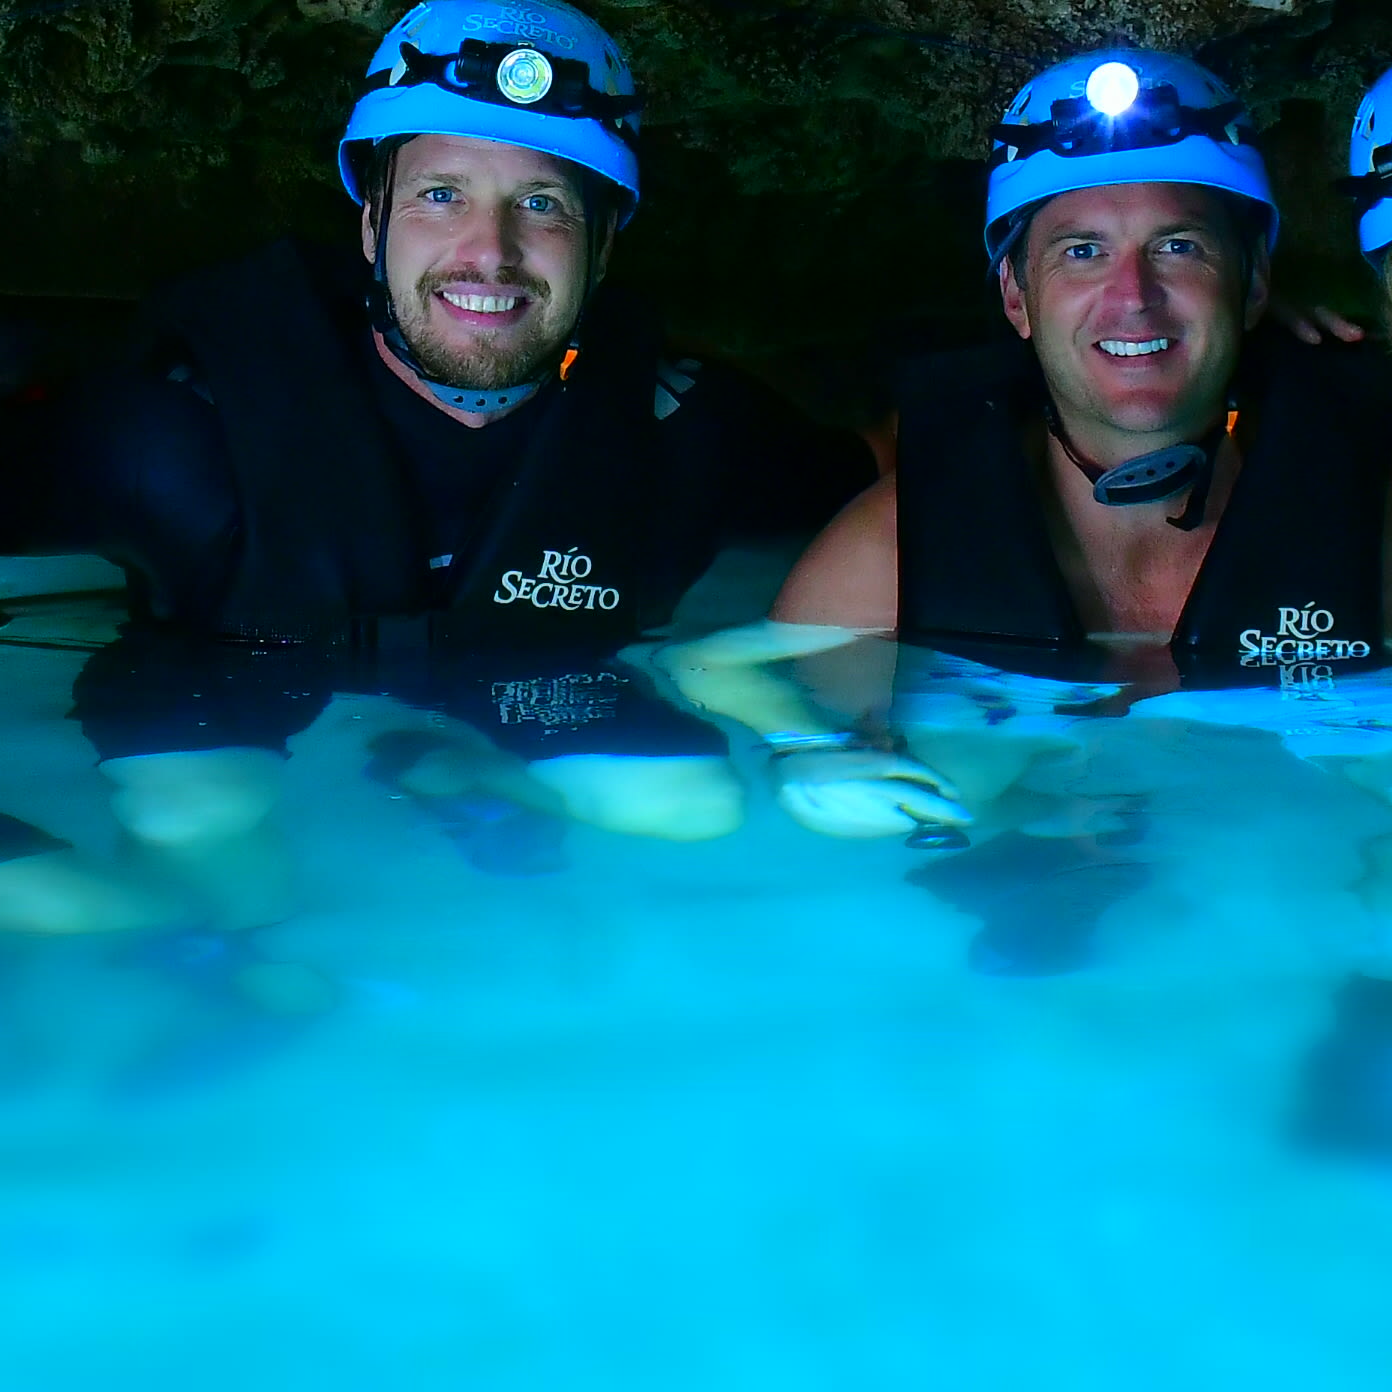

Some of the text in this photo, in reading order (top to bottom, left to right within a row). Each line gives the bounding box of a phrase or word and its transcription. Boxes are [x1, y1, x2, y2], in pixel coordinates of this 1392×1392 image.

[462, 13, 574, 50] SECRETO
[537, 546, 592, 584] RÍO
[493, 570, 620, 611] SECRETO
[1276, 601, 1335, 639] RÍO
